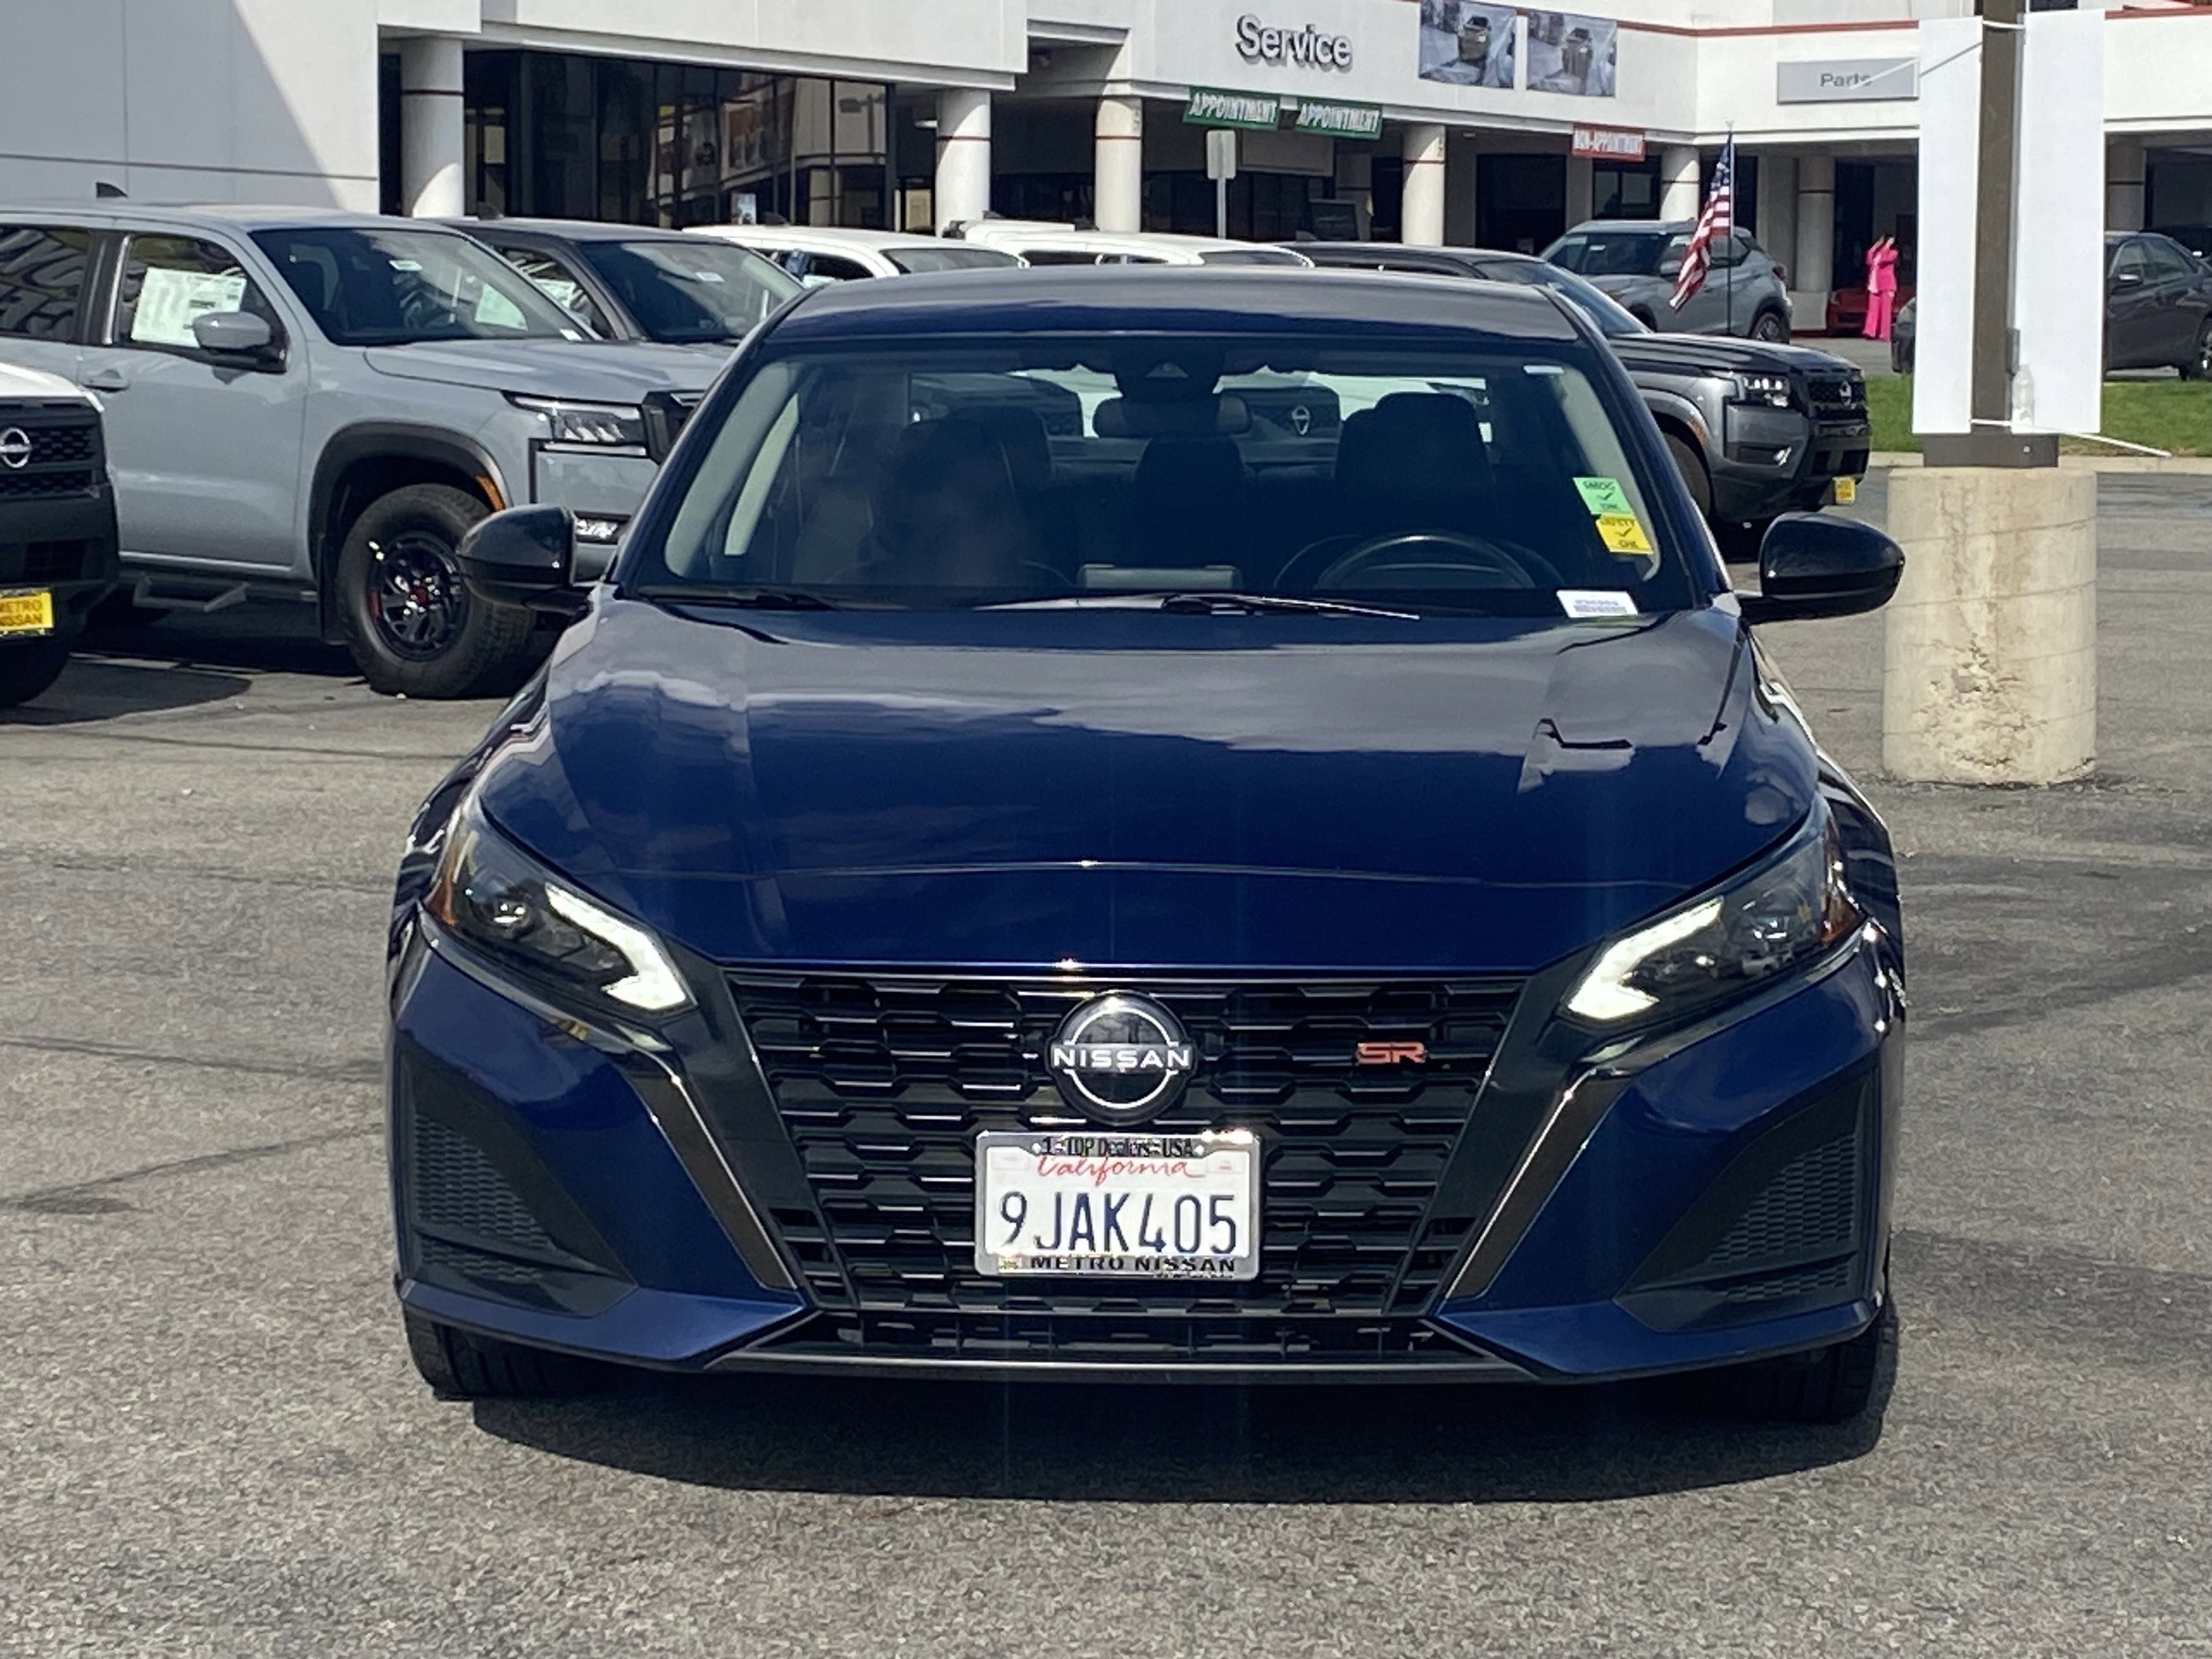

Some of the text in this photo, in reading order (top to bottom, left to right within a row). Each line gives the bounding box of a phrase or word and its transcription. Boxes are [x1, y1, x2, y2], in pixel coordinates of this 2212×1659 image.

[1235, 14, 1353, 66] Service
[1053, 1048, 1190, 1069] NISSAN
[1356, 1041, 1426, 1064] SR
[1036, 1155, 1206, 1187] California
[999, 1191, 1237, 1255] 9JAK405
[1030, 1256, 1125, 1271] METRO
[1135, 1257, 1235, 1272] NISSAN
